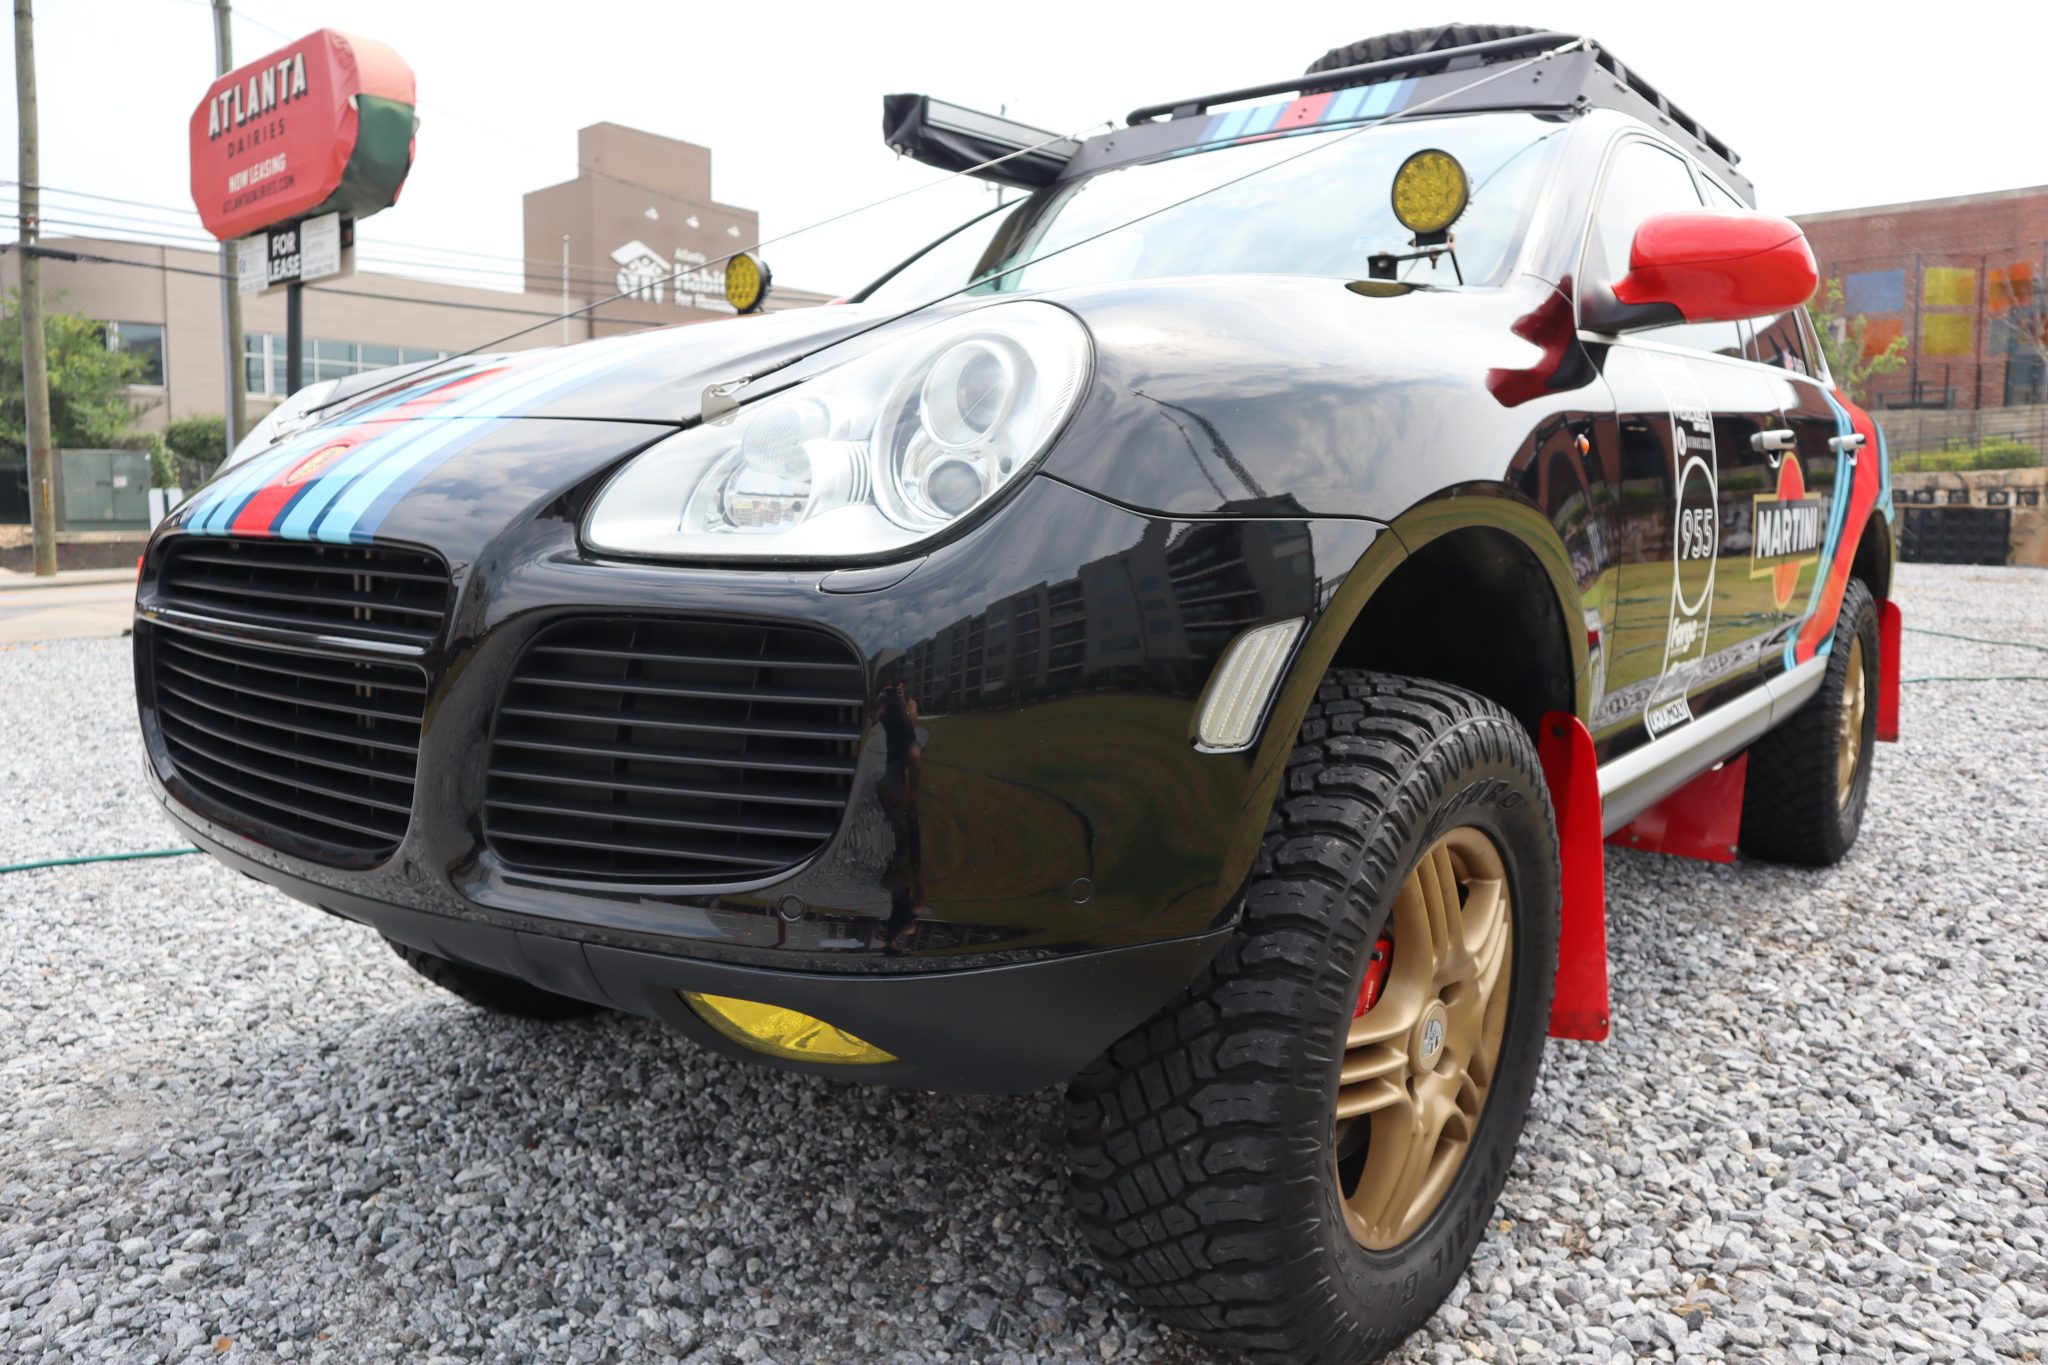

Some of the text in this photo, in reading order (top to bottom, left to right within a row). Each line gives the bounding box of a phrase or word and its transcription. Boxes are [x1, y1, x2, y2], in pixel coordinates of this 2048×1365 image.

[208, 52, 308, 142] ATLANTA
[228, 117, 285, 159] DAIRIES
[228, 152, 287, 194] NOW LEASING
[272, 231, 296, 257] FOR
[268, 253, 300, 282] LEASE
[674, 263, 727, 295] Habit
[1681, 508, 1713, 560] 955
[1756, 507, 1818, 559] MARTINI
